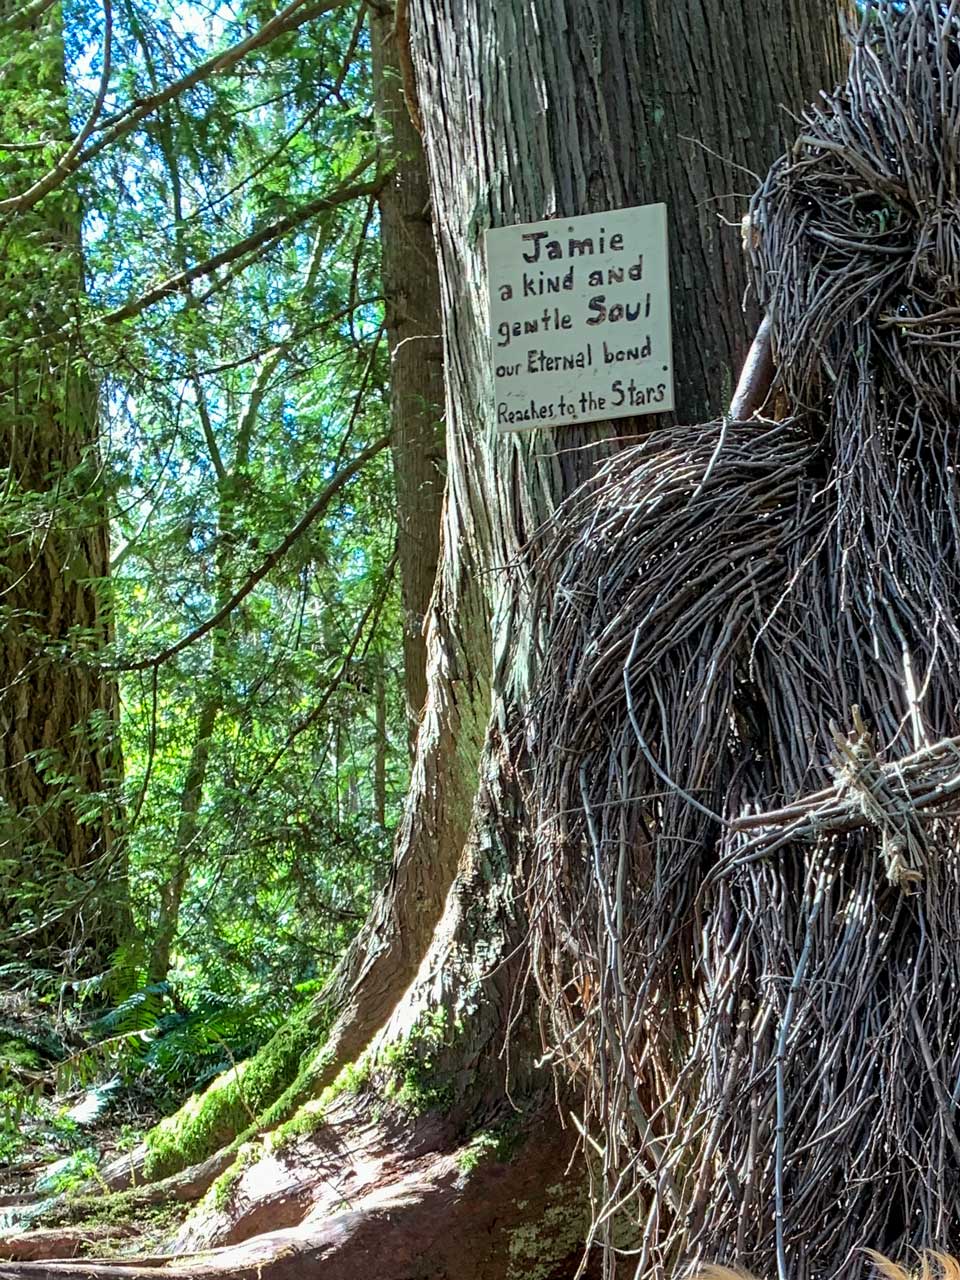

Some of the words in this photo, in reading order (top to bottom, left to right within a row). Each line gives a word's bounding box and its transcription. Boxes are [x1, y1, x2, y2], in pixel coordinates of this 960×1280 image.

[522, 228, 624, 263] Jamie
[499, 284, 512, 301] a
[586, 294, 650, 326] Soul
[496, 364, 521, 378] our
[498, 401, 554, 424] Reaches
[558, 395, 575, 415] to
[579, 392, 606, 413] the
[611, 379, 666, 406] Stars
